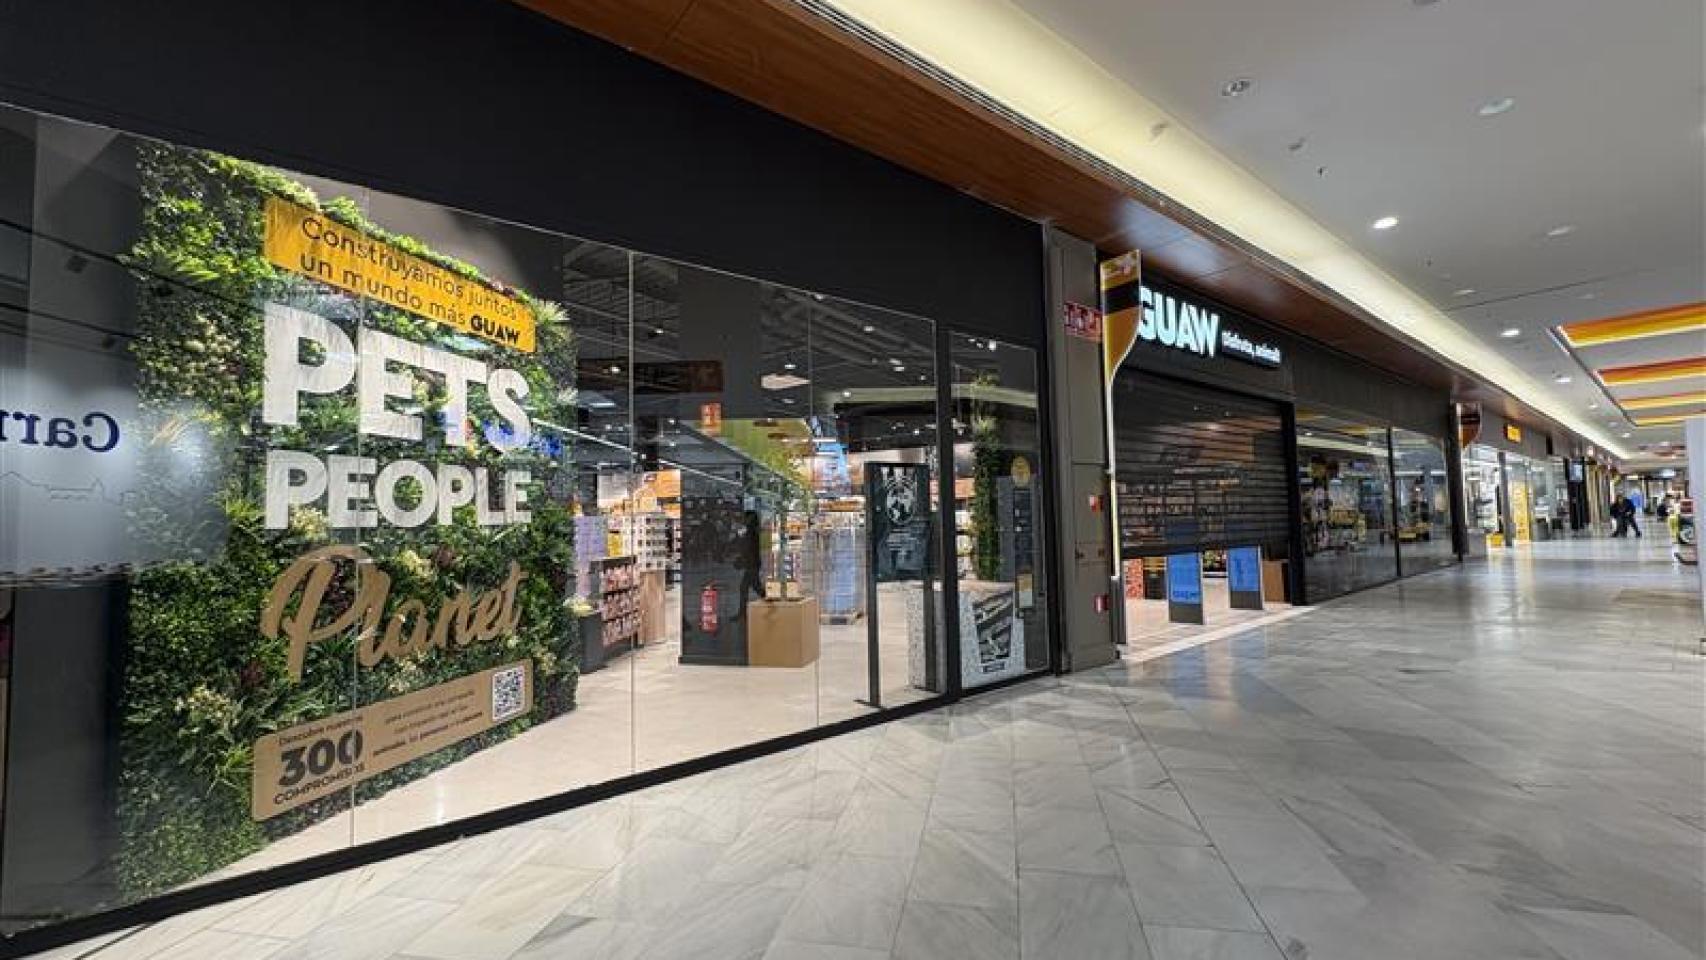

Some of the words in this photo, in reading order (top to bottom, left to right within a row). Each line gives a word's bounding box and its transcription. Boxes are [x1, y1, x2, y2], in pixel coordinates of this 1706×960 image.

[300, 253, 333, 278] un
[343, 270, 422, 310] mundo
[430, 302, 465, 325] más
[470, 315, 520, 344] GUAW
[302, 216, 464, 298] Construyamos
[467, 282, 517, 320] juntos
[1138, 285, 1219, 360] GUAW
[263, 302, 531, 452] PETS
[265, 449, 532, 530] PEOPLE
[259, 543, 529, 683] Planet
[278, 729, 363, 786] 300
